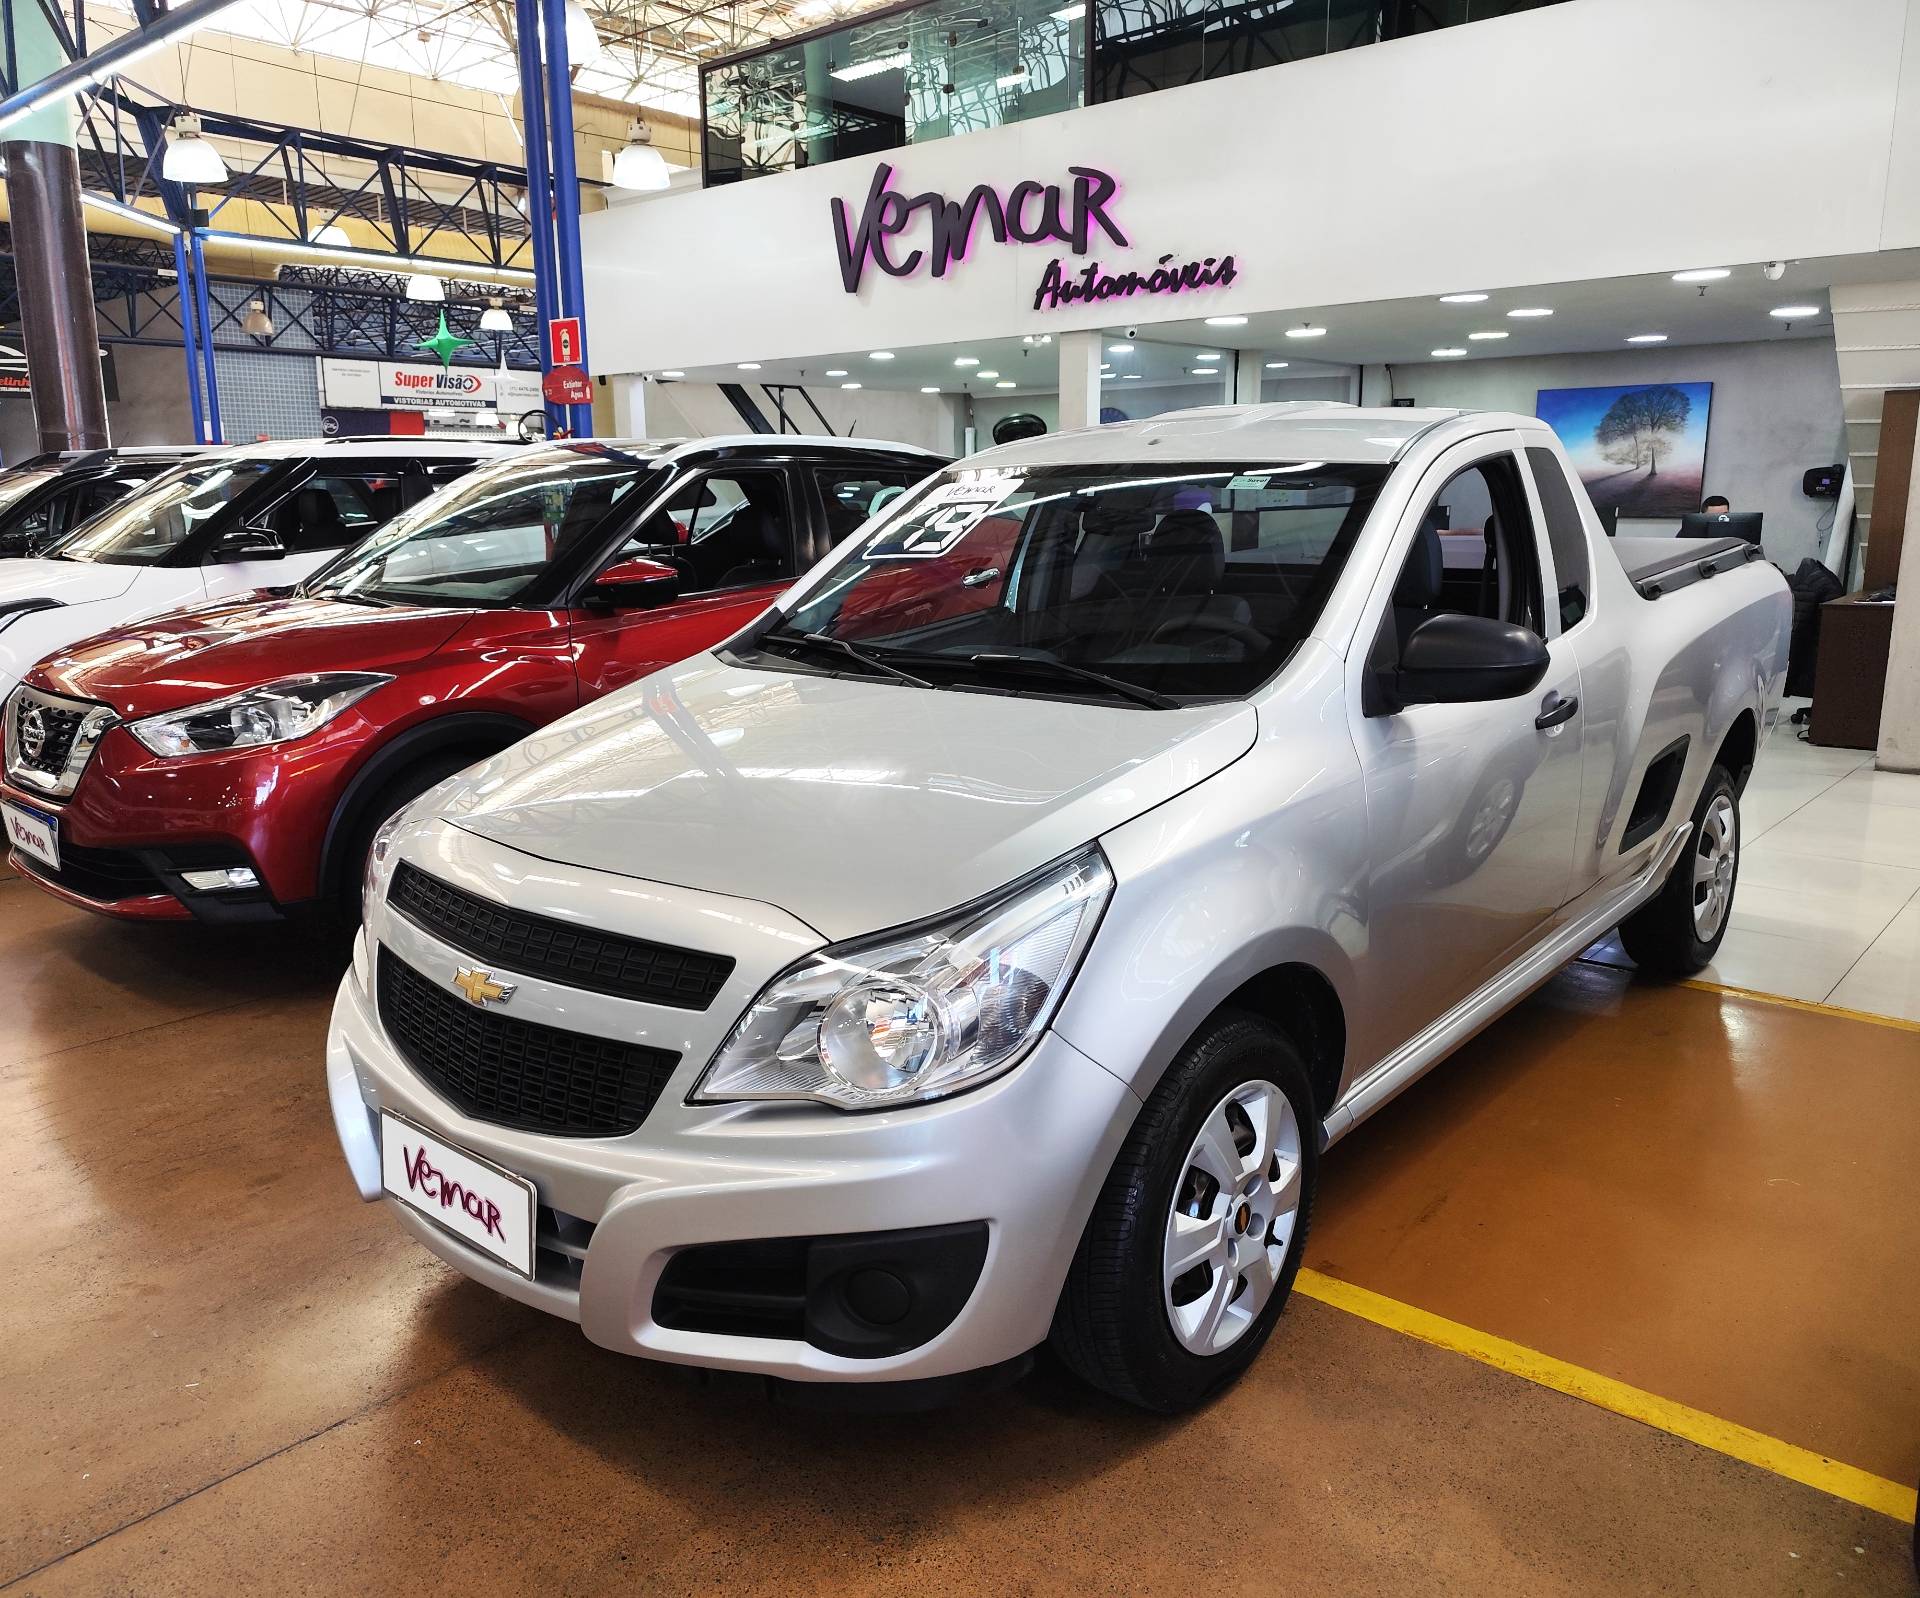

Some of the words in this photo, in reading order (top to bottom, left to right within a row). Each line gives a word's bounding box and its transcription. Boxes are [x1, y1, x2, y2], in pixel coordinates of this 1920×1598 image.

[1033, 254, 1238, 310] Automóveis
[395, 371, 434, 389] Super
[436, 373, 480, 393] Visão
[563, 380, 583, 389] Extintor
[570, 390, 584, 400] Água
[393, 397, 434, 406] VISTORIAS
[435, 399, 487, 408] AUTOMOTIVAS
